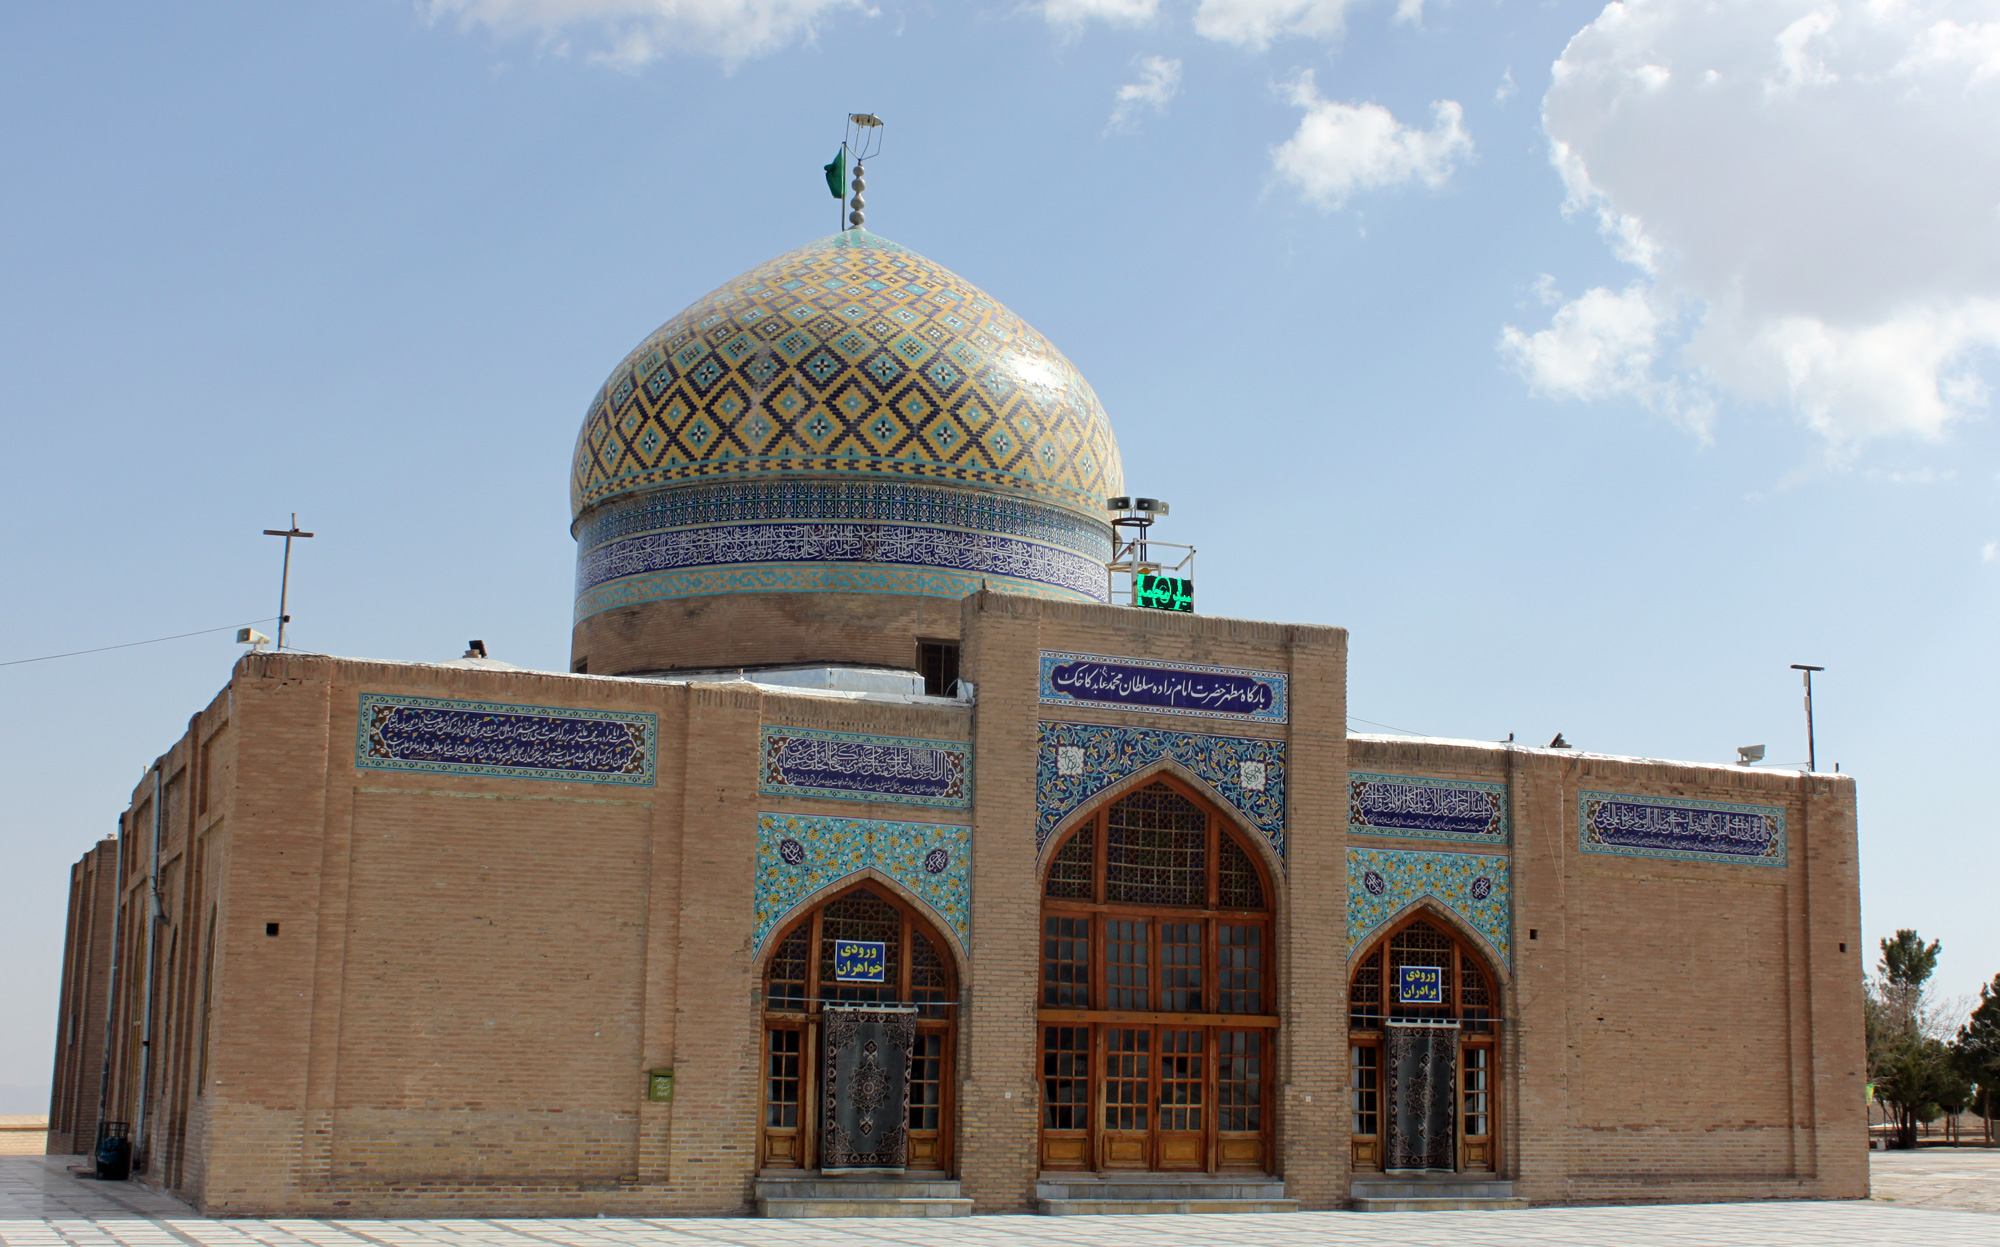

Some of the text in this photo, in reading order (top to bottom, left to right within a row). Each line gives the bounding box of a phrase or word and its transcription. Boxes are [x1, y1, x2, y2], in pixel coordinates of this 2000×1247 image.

[1119, 674, 1154, 697] سلطان
[1191, 683, 1226, 705] حضرت
[1240, 684, 1265, 709] بارگاه
[840, 944, 877, 958] ورودی
[837, 960, 883, 977] خواهران
[1406, 969, 1436, 983] ورودی
[1403, 984, 1437, 999] برادران
